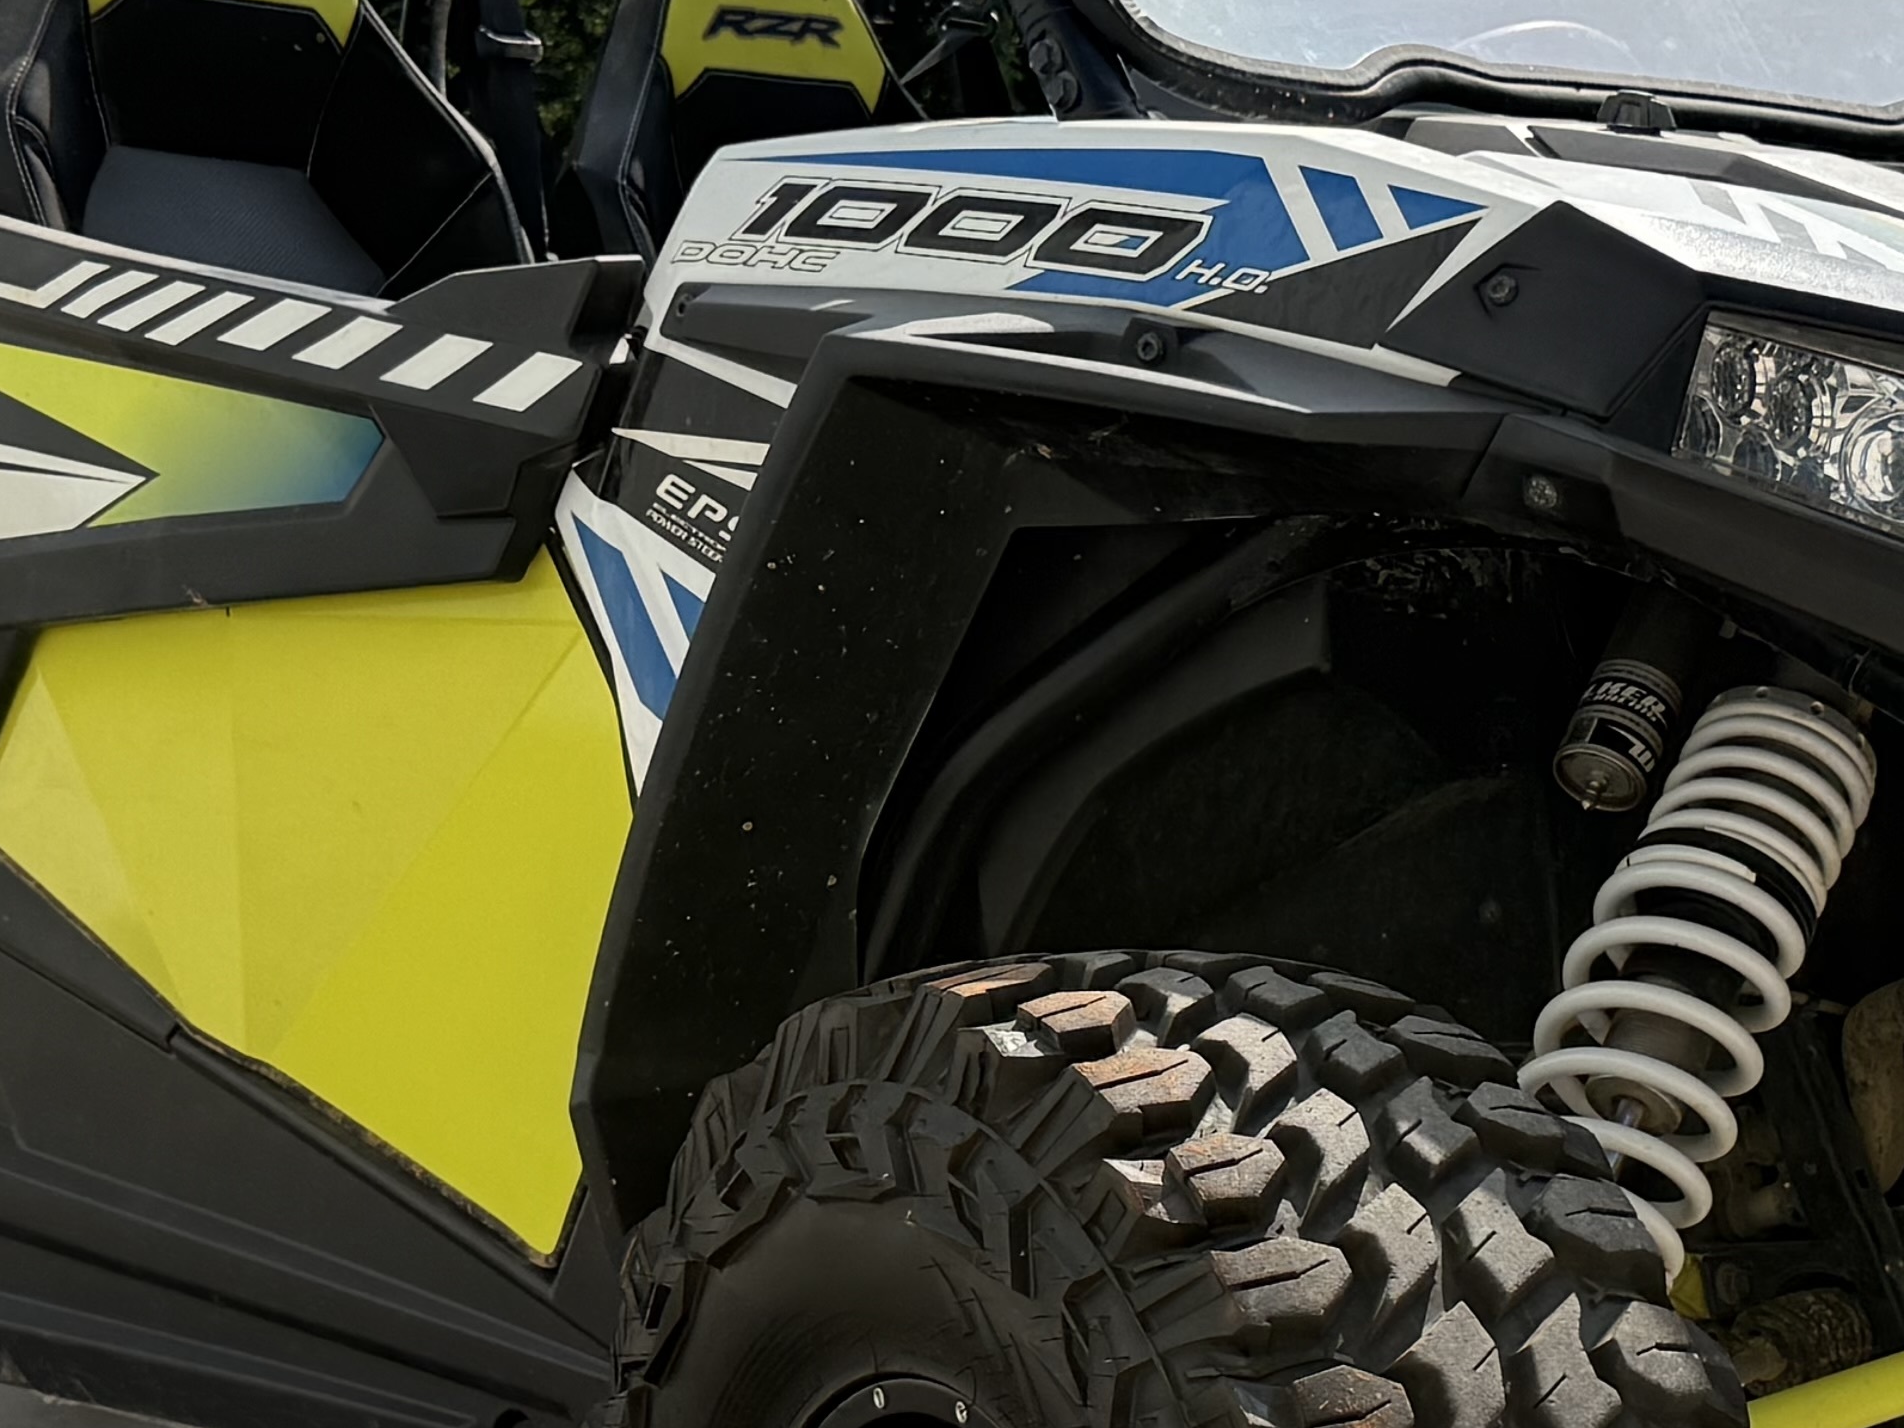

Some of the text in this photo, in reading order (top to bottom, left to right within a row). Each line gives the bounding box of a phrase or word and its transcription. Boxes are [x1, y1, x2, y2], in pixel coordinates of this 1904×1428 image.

[702, 4, 844, 49] RZR
[732, 175, 1213, 281] 1000
[671, 239, 841, 273] DOHC
[645, 508, 689, 542] POWER
